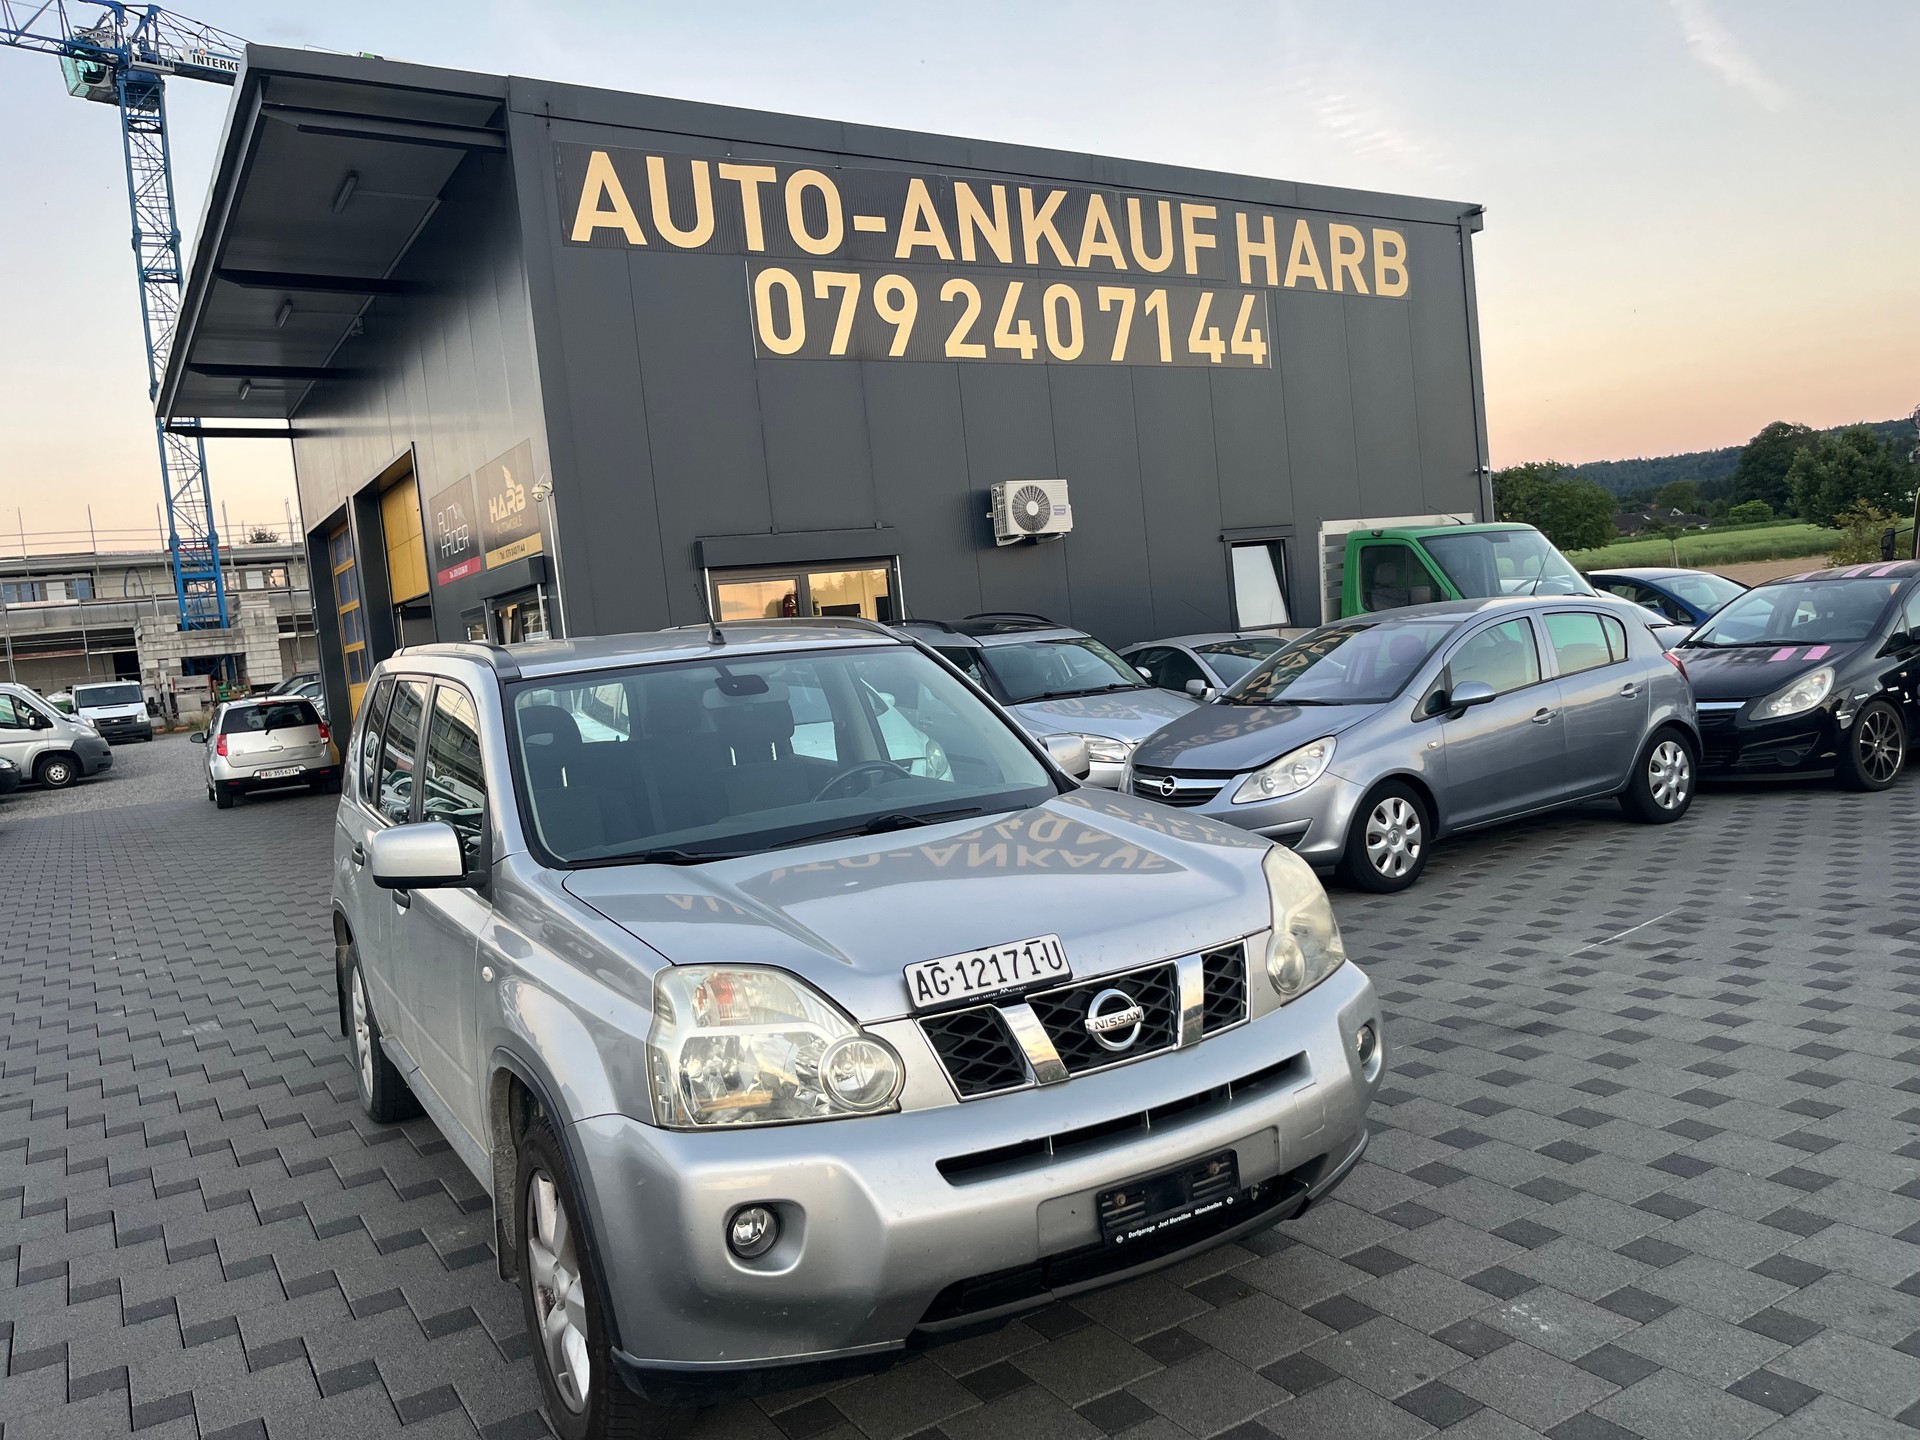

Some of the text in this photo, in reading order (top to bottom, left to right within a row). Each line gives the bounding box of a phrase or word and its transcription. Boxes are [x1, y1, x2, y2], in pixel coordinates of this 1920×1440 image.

[570, 150, 1409, 298] AUTO-ANKAUF HARB
[754, 267, 918, 357] 079
[940, 278, 1084, 361] 240
[488, 483, 527, 523] HARB
[1095, 1009, 1141, 1030] NISSAN
